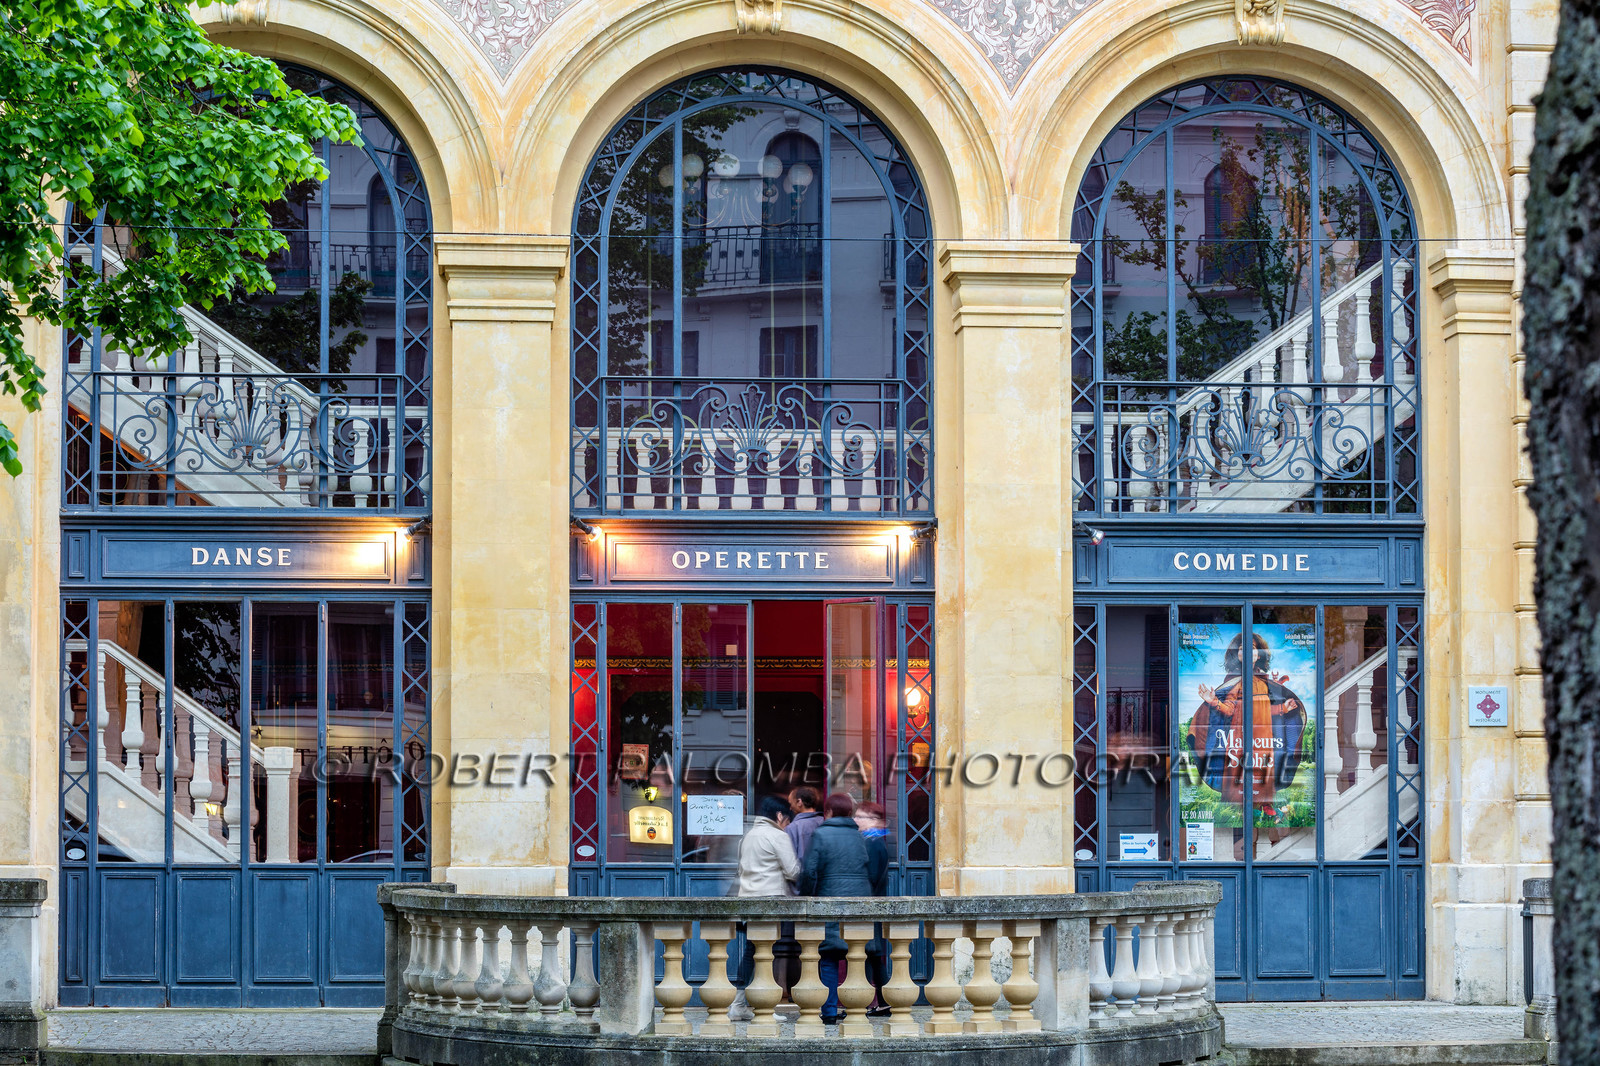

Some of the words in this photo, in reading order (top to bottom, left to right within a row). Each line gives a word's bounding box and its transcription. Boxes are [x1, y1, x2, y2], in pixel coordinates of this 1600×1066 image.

[191, 547, 292, 566] DANSE
[671, 550, 830, 570] OPERETTE
[1173, 552, 1310, 571] COMEDIE
[1181, 810, 1189, 820] LE
[1190, 810, 1197, 820] 20
[1197, 810, 1215, 820] AVRIL
